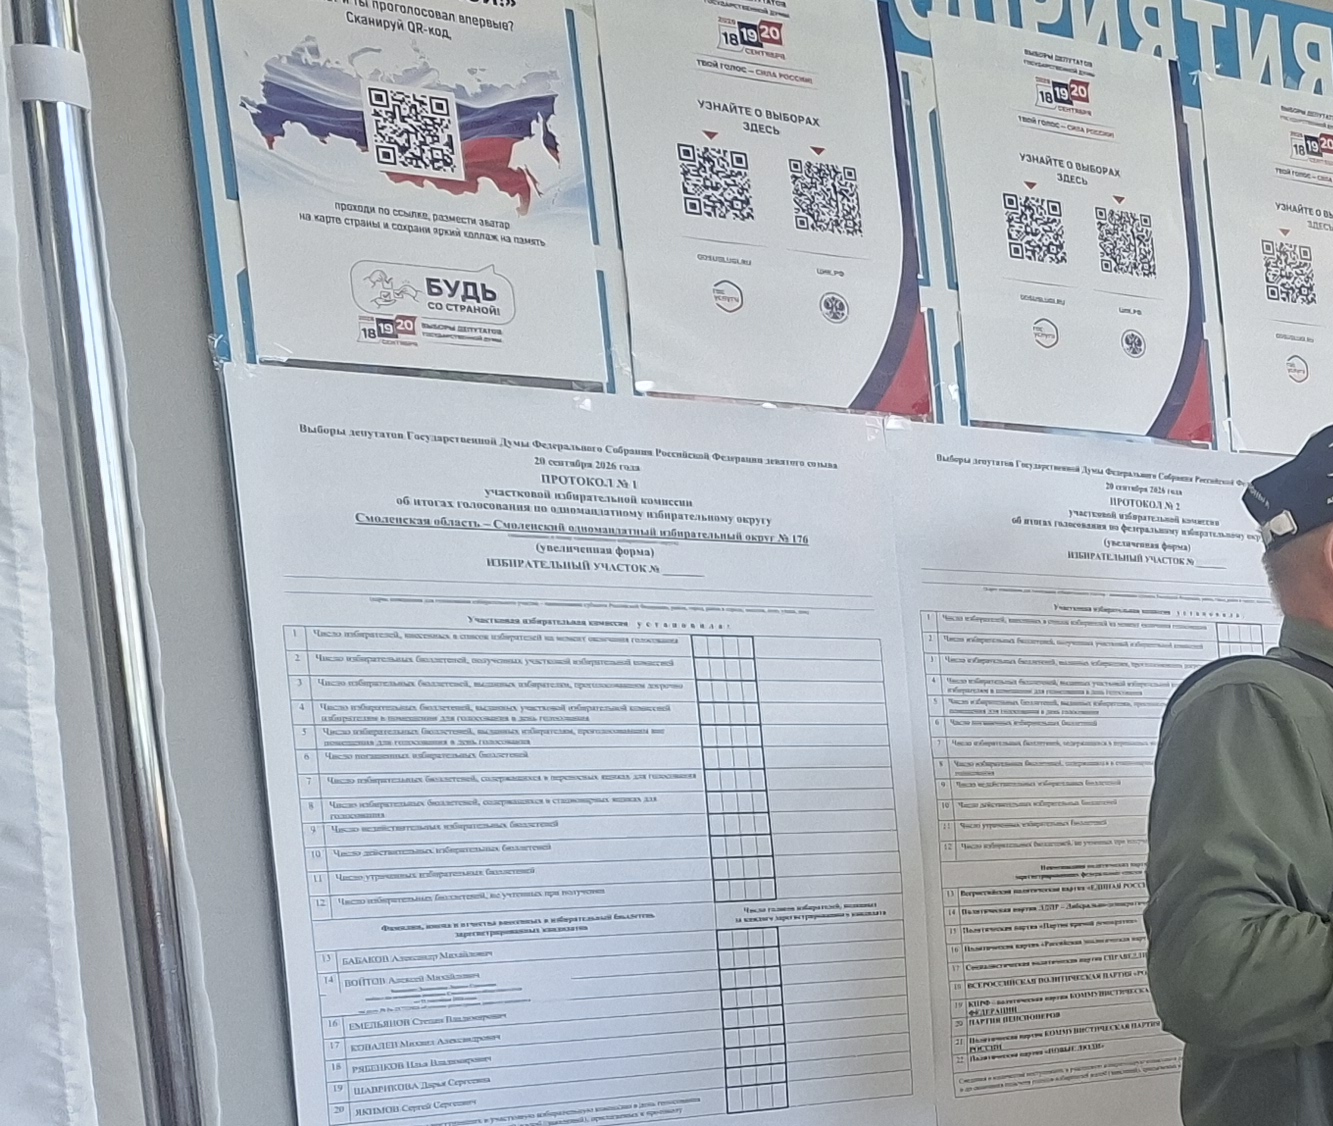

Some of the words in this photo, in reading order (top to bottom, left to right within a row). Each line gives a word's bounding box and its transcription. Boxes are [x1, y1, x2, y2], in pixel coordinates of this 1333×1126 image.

[346, 11, 404, 32] Сканируй
[372, 0, 456, 22] проголосовал
[458, 12, 514, 32] впервые?
[722, 32, 739, 46] 18
[741, 28, 758, 43] 19
[760, 25, 779, 40] 20
[1039, 91, 1053, 104] 18
[1054, 87, 1069, 100] 19
[1070, 84, 1087, 98] 20
[697, 99, 752, 116] УЗНАЙТЕ
[755, 108, 763, 118] О
[766, 109, 820, 127] ВЫБОРАХ
[743, 121, 780, 135] ЗДЕСЬ
[1293, 144, 1305, 156] 18
[1306, 139, 1319, 152] 19
[1320, 137, 1333, 150] 20
[1020, 152, 1065, 168] УЗНАЙТЕ
[1067, 160, 1074, 169] О
[1075, 162, 1121, 178] ВЫБОРАХ
[1057, 172, 1088, 185] ЗДЕСЬ
[335, 201, 376, 214] проходи
[378, 206, 390, 216] по
[393, 208, 431, 221] ссылке,
[433, 213, 477, 225] размести
[479, 218, 510, 230] аватар
[1275, 201, 1314, 216] УЗНАЙТЕ
[1315, 208, 1322, 217] О
[299, 212, 312, 221] на
[344, 217, 381, 229] страны
[392, 222, 431, 234] сохрани
[425, 276, 497, 303] БУДЬ
[428, 301, 443, 310] СО
[446, 303, 500, 316] СТРАНОЙ!
[378, 323, 393, 335] 19
[396, 319, 413, 331] 20
[361, 327, 376, 339] 18
[541, 474, 613, 487] ПРОТОКОЛ
[617, 478, 628, 489] №
[633, 479, 637, 489] 1
[485, 488, 551, 499] участковой
[555, 491, 638, 504] избирательной
[641, 497, 693, 507] комиссии
[1110, 497, 1162, 509] ПРОТОКОЛ
[1176, 502, 1180, 511] 2
[397, 495, 410, 506] об
[414, 498, 454, 508] итогах
[457, 501, 530, 512] голосования
[534, 505, 548, 513] по
[551, 506, 644, 520] одномандатному
[647, 509, 734, 524] избирательному
[737, 516, 771, 527] округу
[355, 512, 431, 525] Смоленская
[434, 517, 480, 528] область
[493, 519, 564, 533] Смоленский
[568, 526, 656, 538] одномандатный
[660, 529, 742, 542] избирательный
[777, 534, 789, 544] №
[792, 535, 809, 545] 176
[536, 543, 612, 554] (увеличенная
[615, 545, 654, 558] форма)
[1068, 550, 1143, 562] ИЗБИРАТЕЛЬНЫЙ
[487, 558, 590, 570] ИЗБИРАТЕЛЬНЫЙ
[594, 562, 647, 573] УЧАСТОК
[321, 953, 331, 962] 13
[343, 955, 390, 965] БАБАКОВ
[324, 976, 333, 984] 14
[328, 1019, 338, 1028] 16
[349, 1018, 410, 1031] ЕМЕЛЬЯНОВ
[330, 1041, 340, 1050] 17
[331, 1062, 341, 1071] 18
[333, 1084, 343, 1093] 19
[334, 1105, 344, 1114] 20
[355, 1105, 400, 1116] ЯКИМОВ
